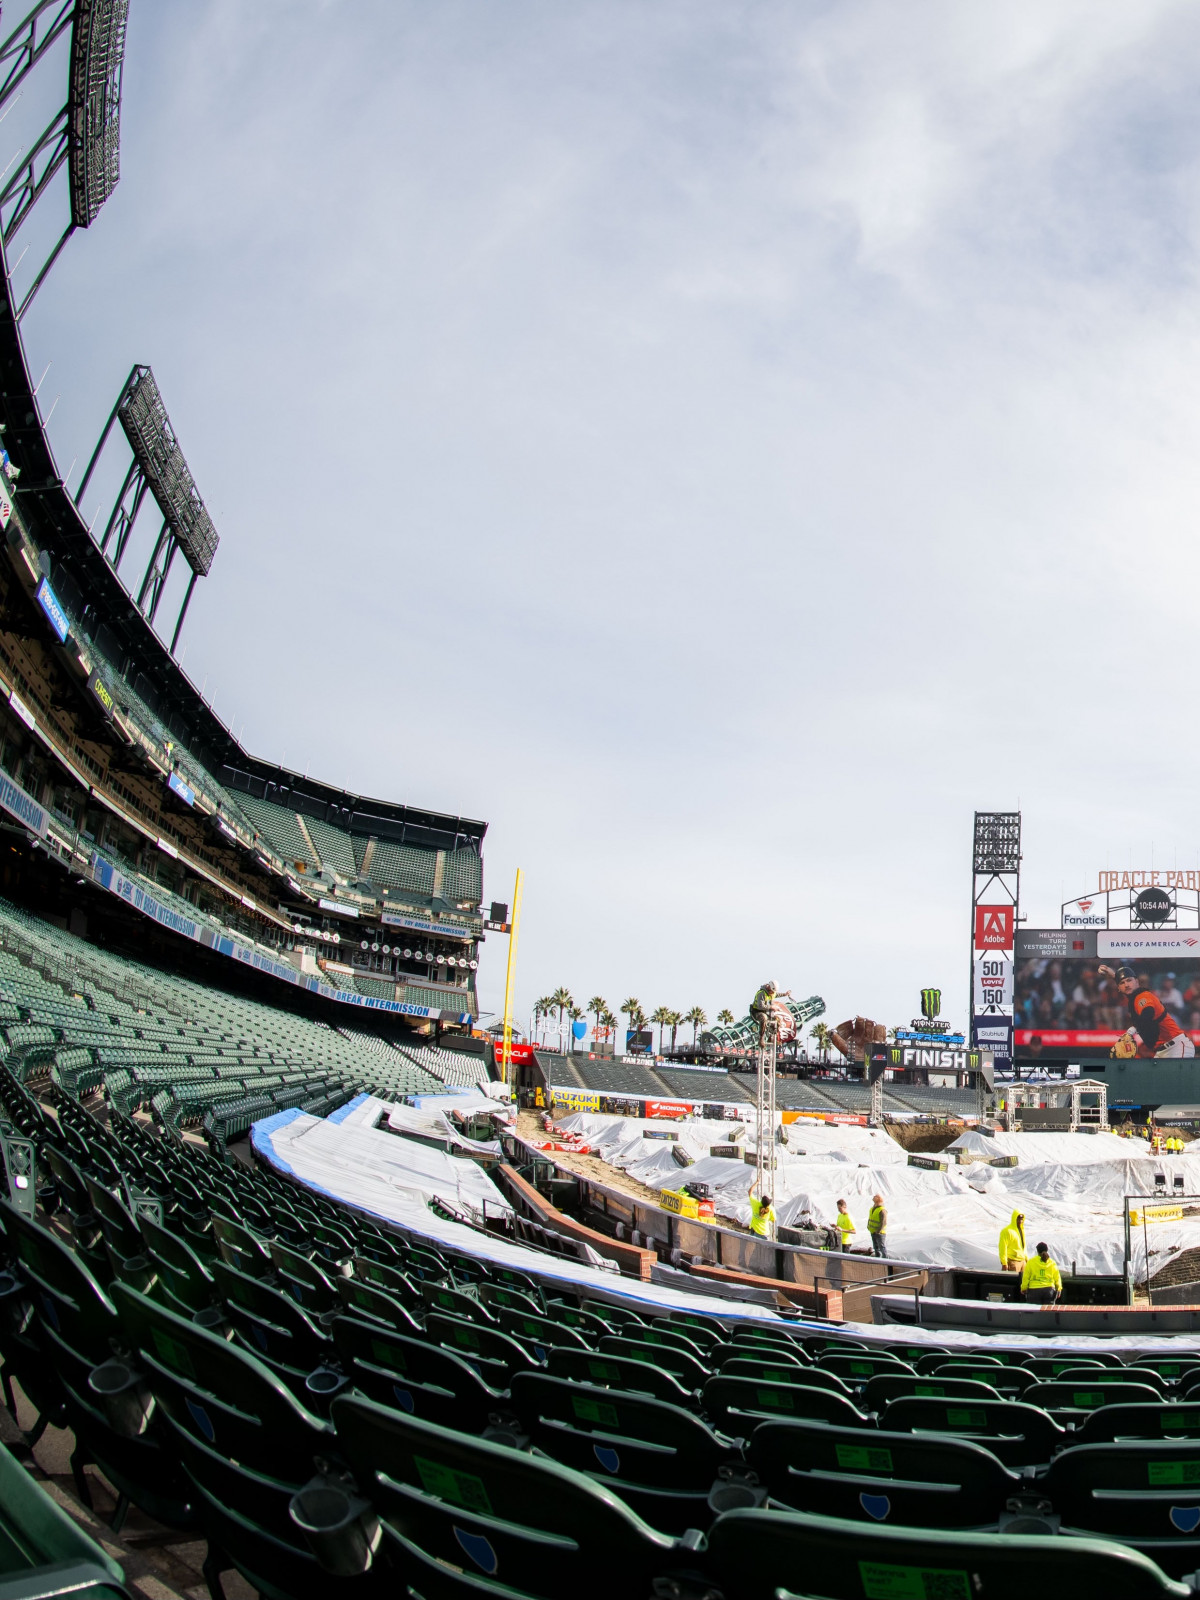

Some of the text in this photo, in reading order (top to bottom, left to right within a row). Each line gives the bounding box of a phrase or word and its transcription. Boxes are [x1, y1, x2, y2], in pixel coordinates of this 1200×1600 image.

[1098, 870, 1160, 893] ORACLE
[1139, 901, 1169, 910] 10:54 AM
[157, 904, 197, 938] INTERMISSION
[1063, 914, 1106, 926] Fanatics
[414, 922, 431, 930] BREAK
[431, 925, 467, 936] INTERMISSION
[983, 935, 1005, 943] Adobe
[982, 961, 1004, 976] 501
[336, 990, 362, 1005] BREAK
[364, 997, 430, 1017] INTERMISSION
[530, 1017, 569, 1036] blue
[912, 1019, 951, 1028] MONSTER
[896, 1031, 966, 1044] SUPERCROSS
[622, 1056, 637, 1064] FAN
[903, 1049, 967, 1069] FINISH
[553, 1091, 599, 1104] SUZUKI
[659, 1105, 688, 1113] HONDA
